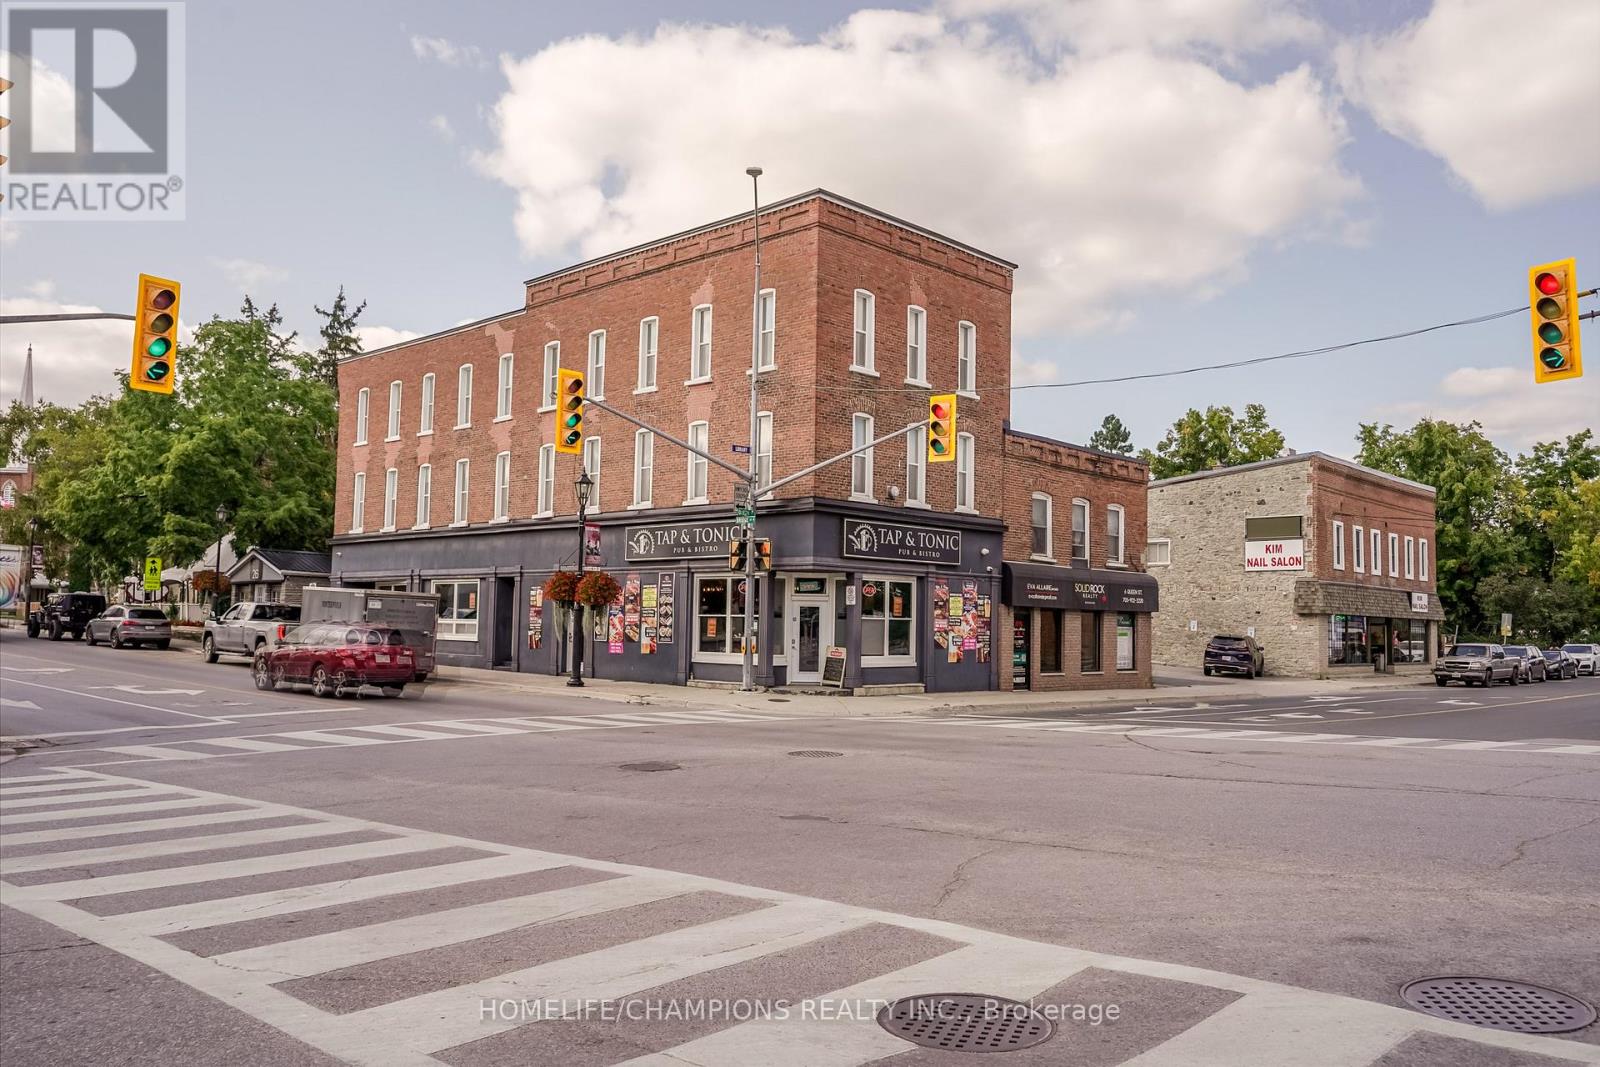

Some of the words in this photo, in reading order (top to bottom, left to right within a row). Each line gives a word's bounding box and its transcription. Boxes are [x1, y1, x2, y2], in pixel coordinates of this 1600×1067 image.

[655, 529, 677, 545] TAP
[680, 529, 691, 544] &
[693, 525, 740, 543] TONIC
[878, 528, 902, 545] TAP
[905, 531, 916, 547] &
[917, 532, 959, 551] TONIC
[694, 545, 718, 553] BISTRO
[898, 548, 910, 556] PUB
[919, 550, 941, 558] BISTRO
[1265, 544, 1283, 554] KIM
[1247, 557, 1268, 567] NAIL
[1271, 556, 1302, 567] SALON
